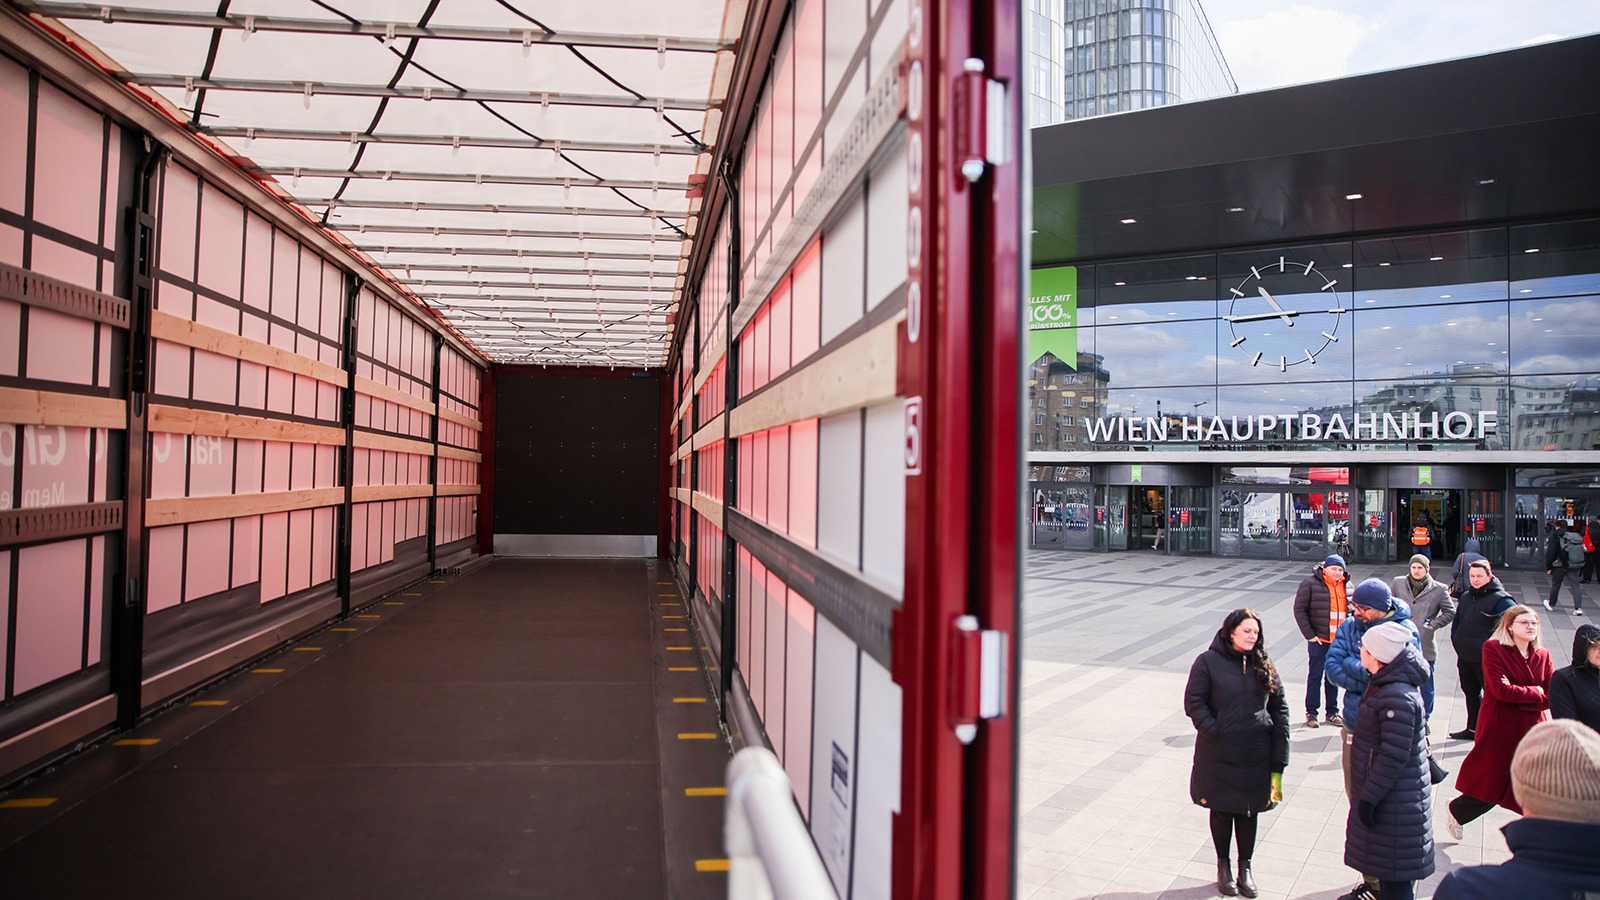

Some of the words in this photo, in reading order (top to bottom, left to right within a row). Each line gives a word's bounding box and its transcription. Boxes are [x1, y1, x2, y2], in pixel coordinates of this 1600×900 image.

[1054, 294, 1072, 302] MIT
[1027, 304, 1071, 322] 100%
[1085, 416, 1168, 441] WIEN
[1182, 410, 1497, 441] HAUPTBAHNHOF
